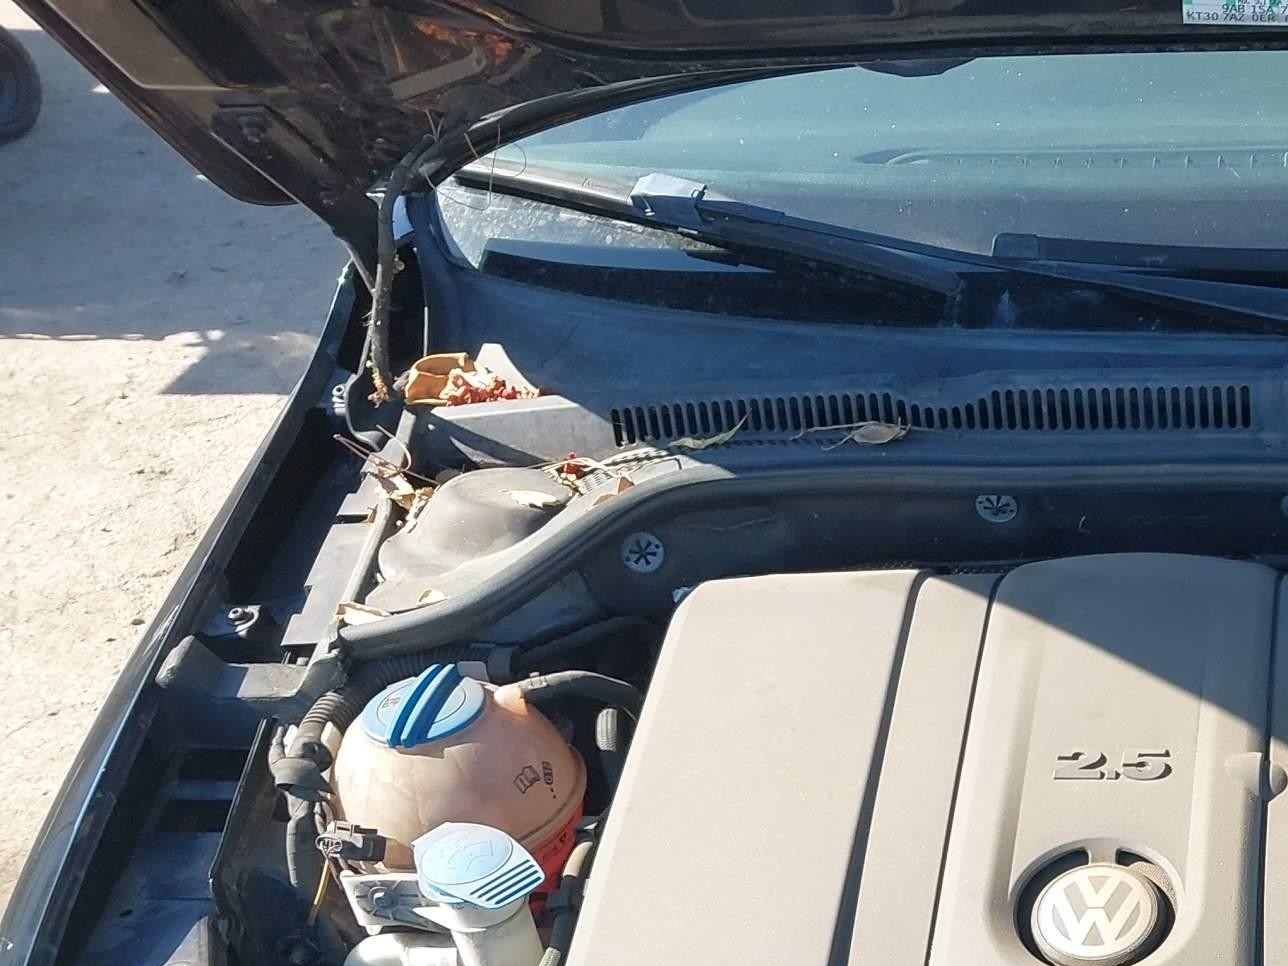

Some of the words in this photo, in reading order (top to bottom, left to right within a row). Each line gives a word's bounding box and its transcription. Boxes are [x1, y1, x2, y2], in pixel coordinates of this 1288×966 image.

[1222, 4, 1246, 14] 9AB
[1223, 13, 1246, 22] 7AZ
[1052, 747, 1174, 782] 2.5
